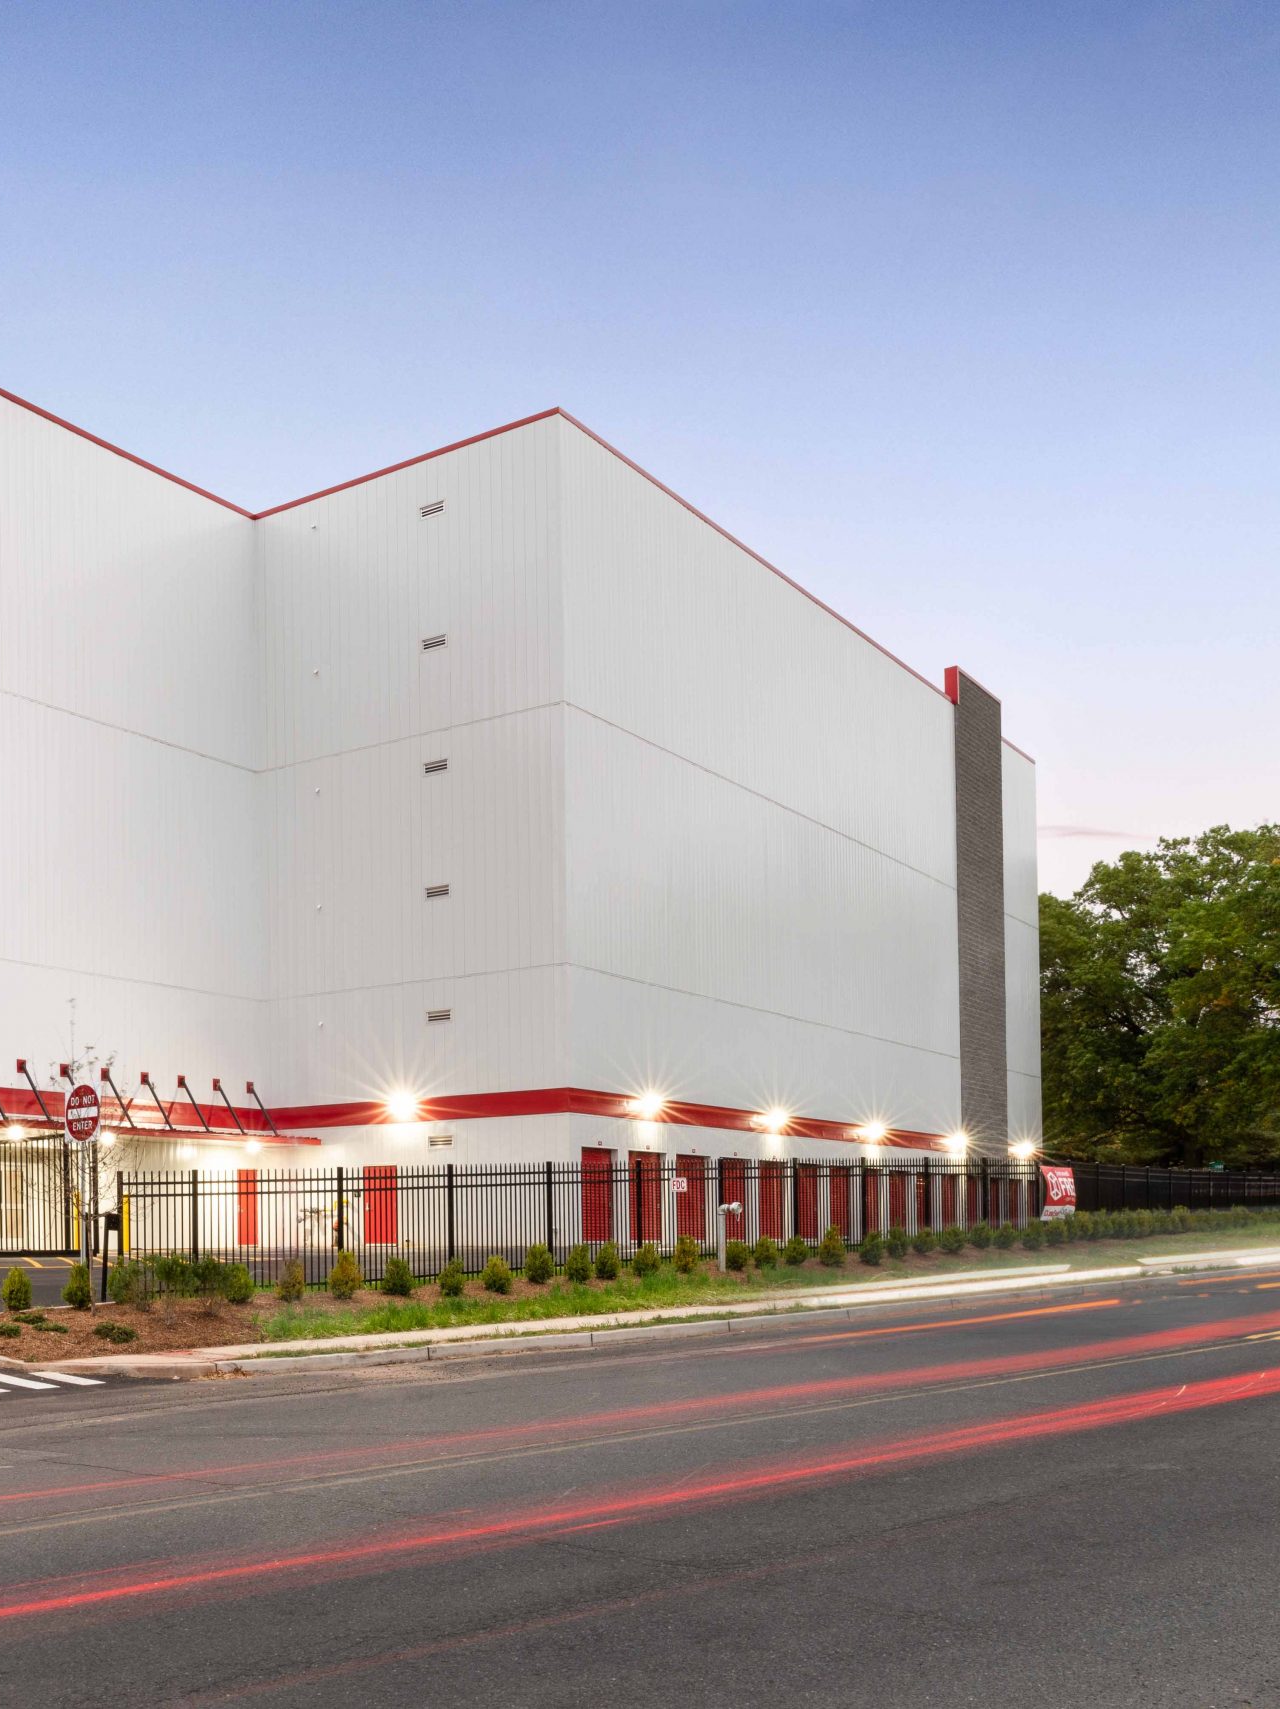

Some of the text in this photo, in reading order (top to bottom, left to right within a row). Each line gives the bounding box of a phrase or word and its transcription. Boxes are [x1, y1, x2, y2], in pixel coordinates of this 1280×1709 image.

[70, 1094, 95, 1106] DO NOT
[72, 1120, 93, 1131] ENTER
[672, 1180, 686, 1190] FDC
